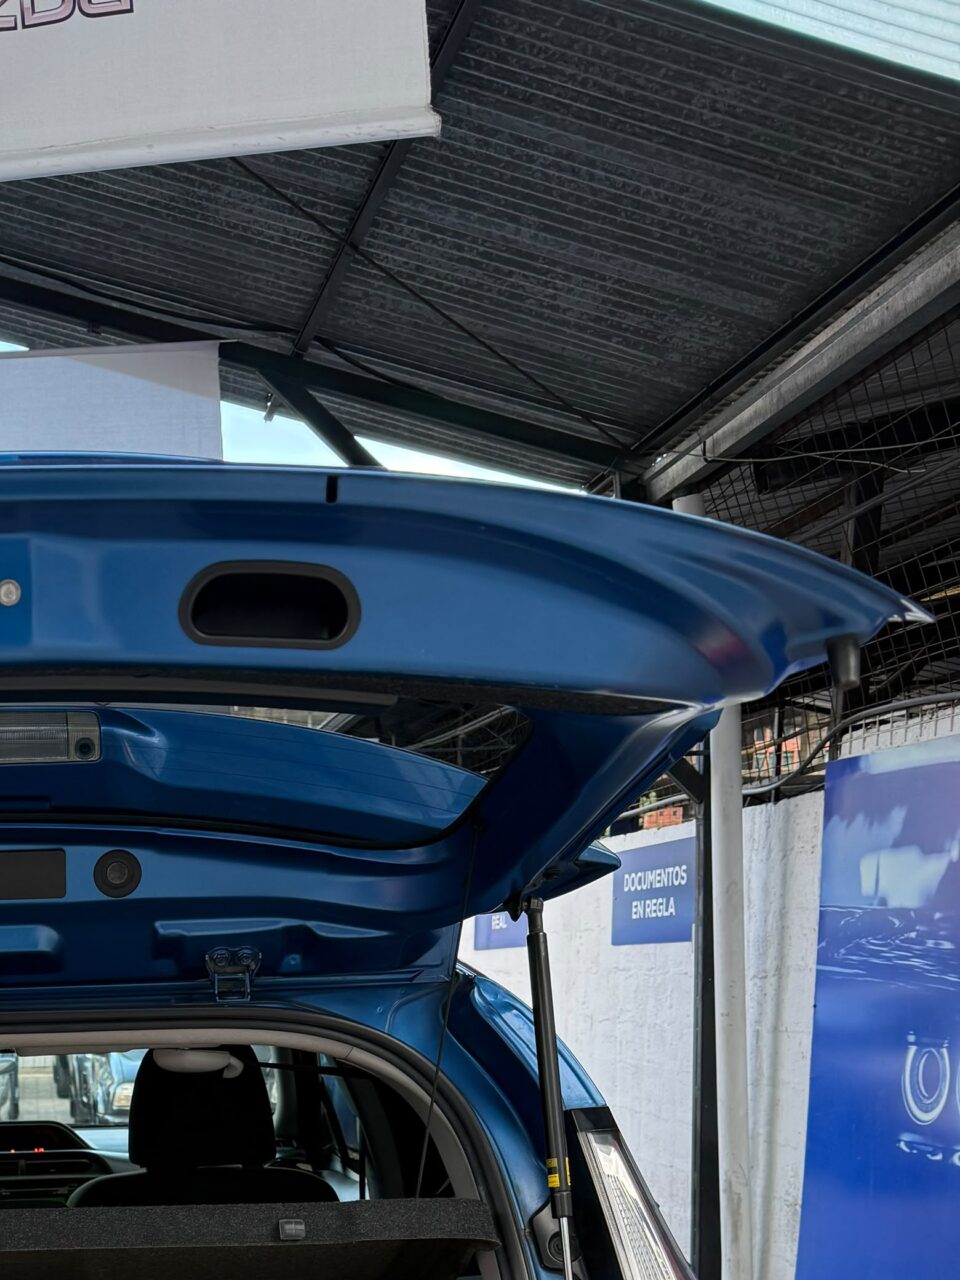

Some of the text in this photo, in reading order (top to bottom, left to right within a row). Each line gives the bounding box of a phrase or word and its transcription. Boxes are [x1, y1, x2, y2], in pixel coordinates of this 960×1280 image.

[623, 864, 688, 892] DOCUMENTOS
[631, 896, 676, 919] EN REGLA
